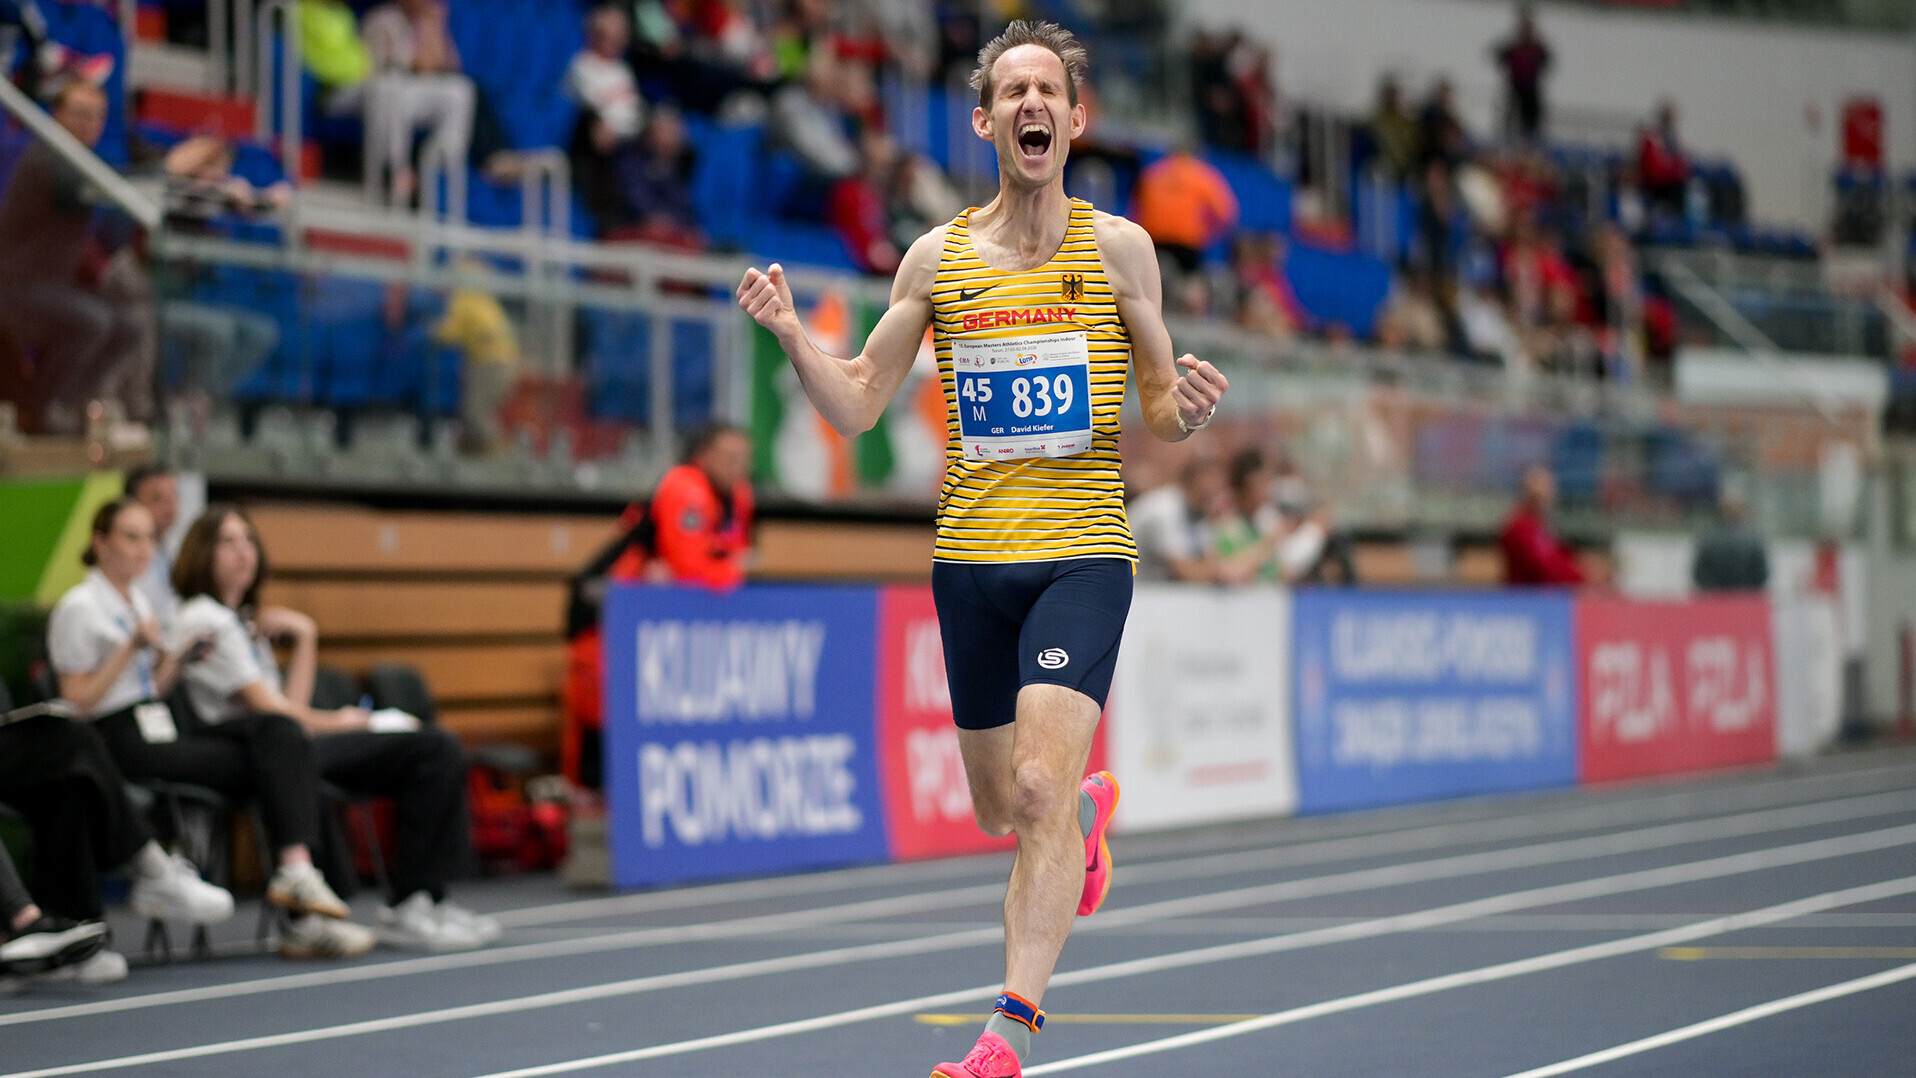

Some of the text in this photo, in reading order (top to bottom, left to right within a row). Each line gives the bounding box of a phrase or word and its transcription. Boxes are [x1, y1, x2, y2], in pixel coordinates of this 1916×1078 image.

[963, 308, 1076, 330] GERMANY
[962, 373, 1074, 418] 45 839
[973, 406, 987, 421] M
[1011, 425, 1032, 433] David
[638, 732, 862, 848] POMORZE
